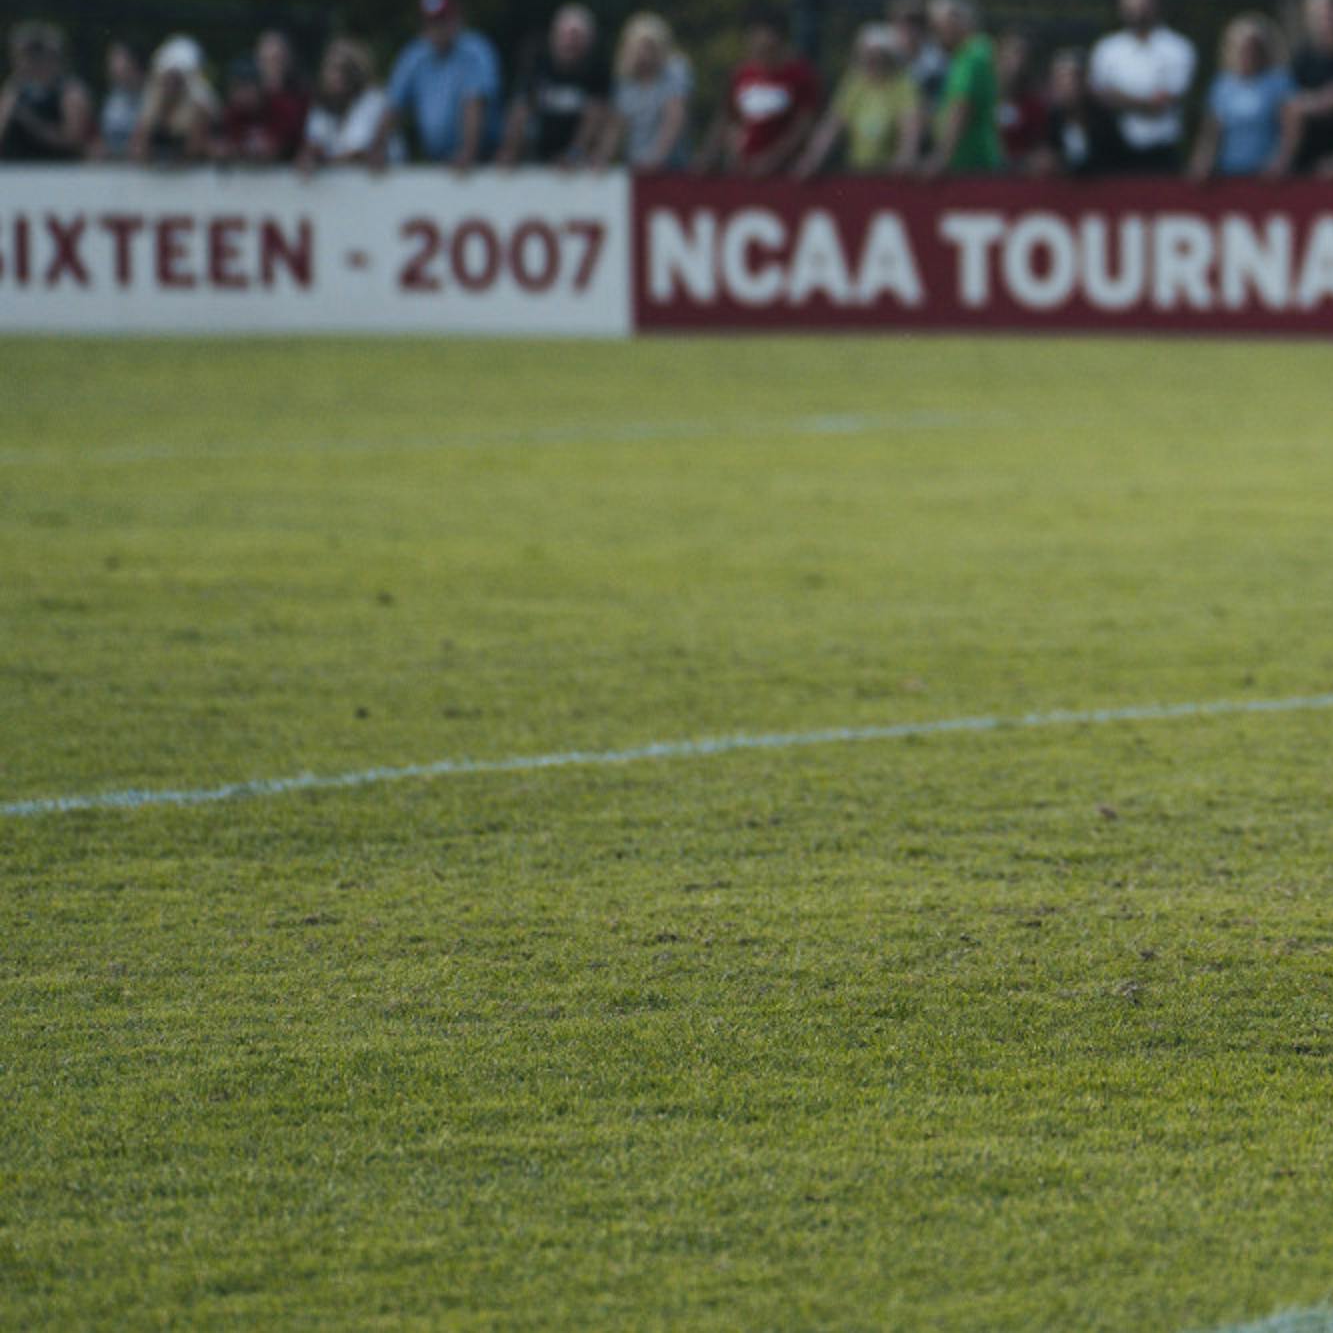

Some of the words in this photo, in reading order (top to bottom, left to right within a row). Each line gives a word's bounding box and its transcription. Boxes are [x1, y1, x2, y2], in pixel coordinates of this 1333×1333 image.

[0, 214, 314, 290] IXTEEN
[397, 217, 607, 294] 2007
[649, 210, 922, 304] NCAA
